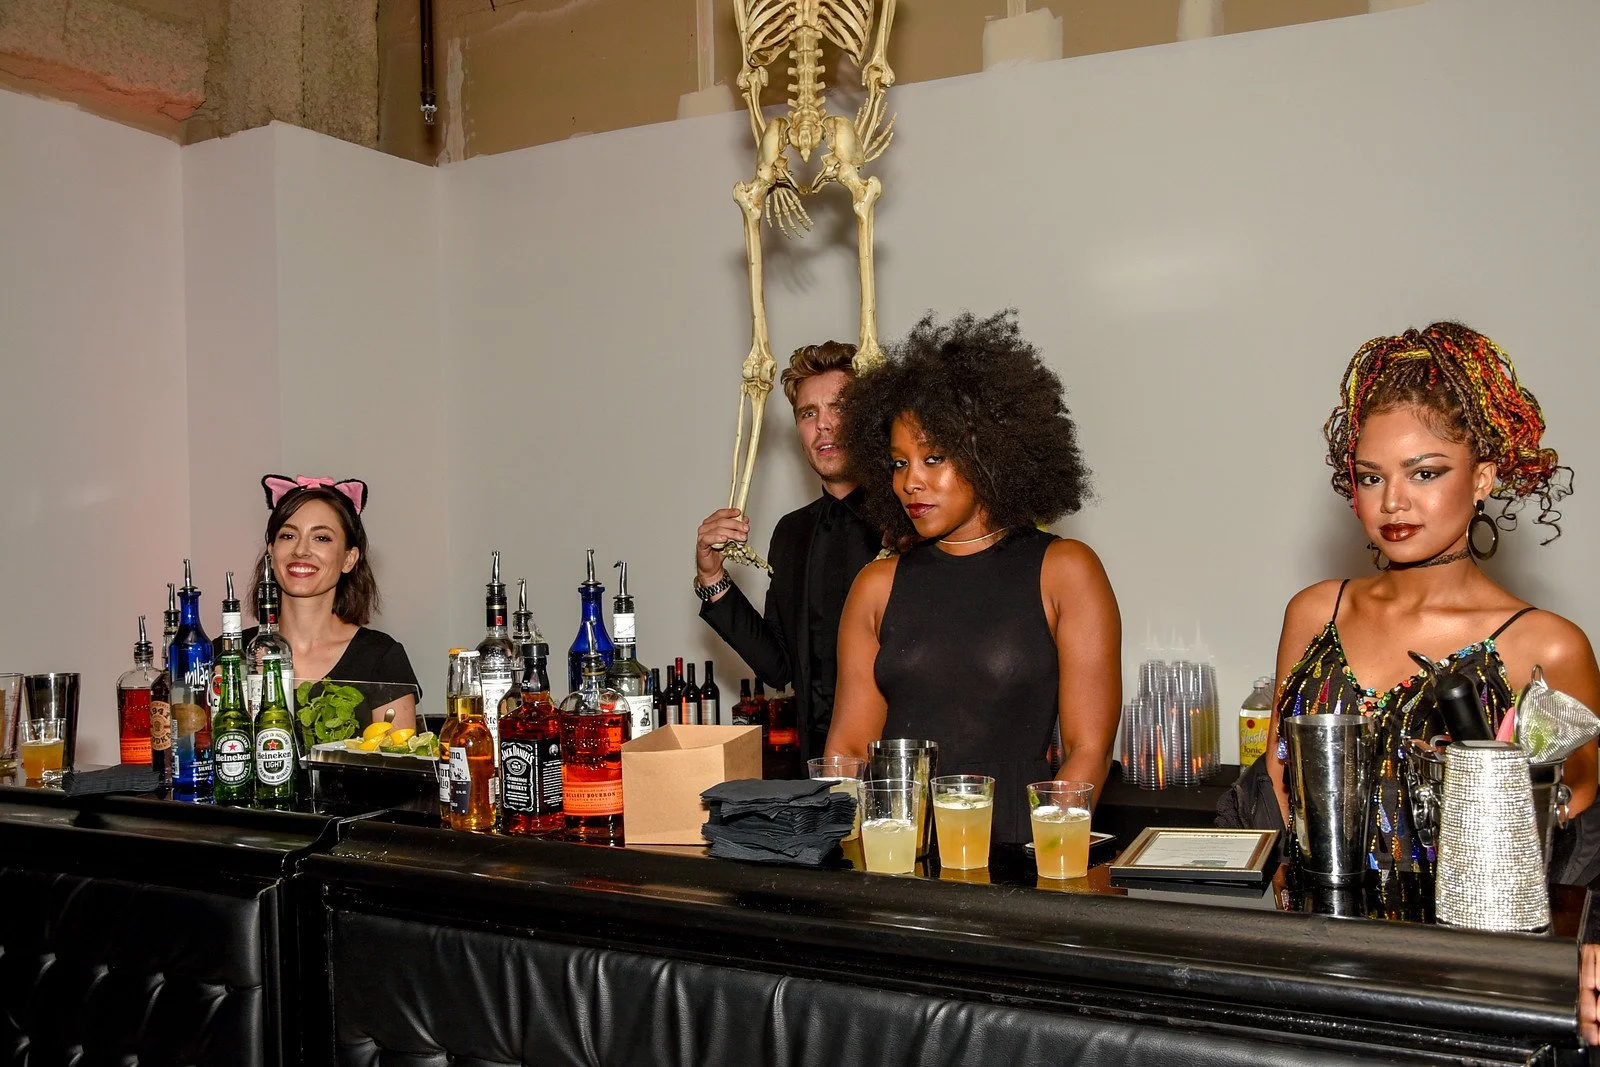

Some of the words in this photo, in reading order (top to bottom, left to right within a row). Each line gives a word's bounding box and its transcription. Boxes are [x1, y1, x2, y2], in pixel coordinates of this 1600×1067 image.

[1244, 745, 1263, 754] Tonic
[215, 753, 251, 762] Heineken
[257, 750, 292, 760] Heineken
[501, 748, 513, 761] JACK
